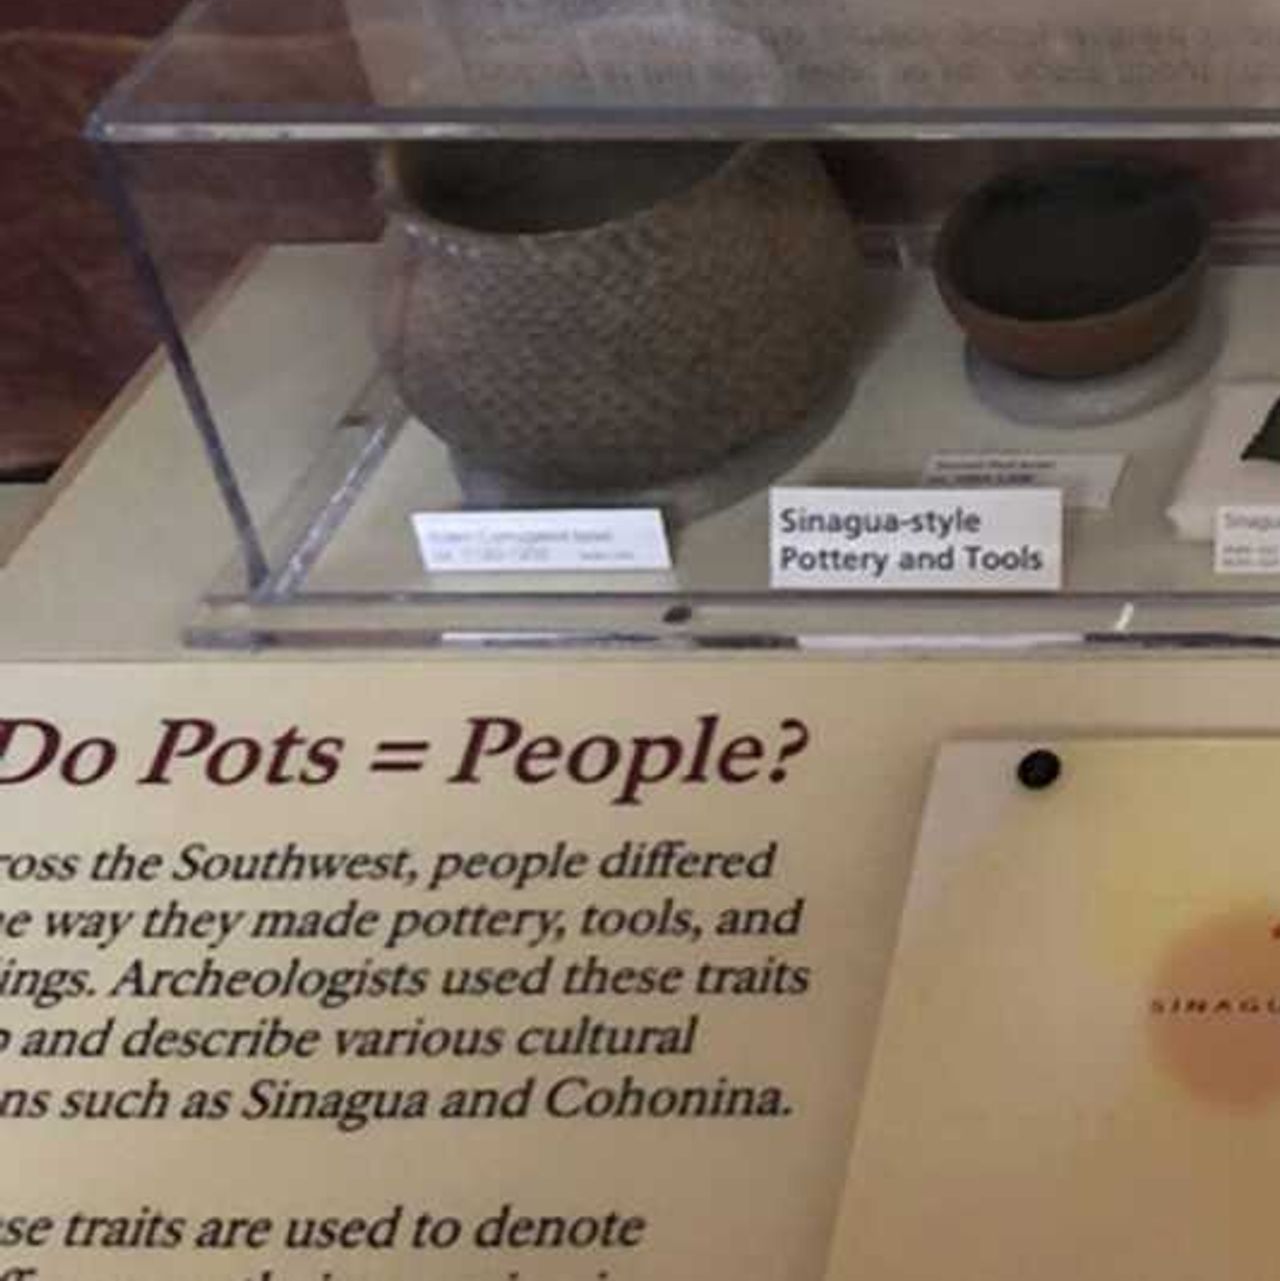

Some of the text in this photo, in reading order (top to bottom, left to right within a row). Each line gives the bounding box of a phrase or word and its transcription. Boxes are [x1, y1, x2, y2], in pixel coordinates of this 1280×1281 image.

[780, 507, 981, 540] Sinagua-style
[781, 546, 1043, 577] Pottery and Tools
[0, 715, 809, 805] Do Pots = People?
[91, 841, 777, 890] the Southwest, people differed
[110, 956, 809, 1008] Archeologists used these traits
[21, 1018, 115, 1057] and
[122, 1018, 320, 1057] describe
[337, 1019, 504, 1057] various
[517, 1015, 698, 1055] cultural
[60, 1076, 791, 1132] such as Sinagua and Cohonina.
